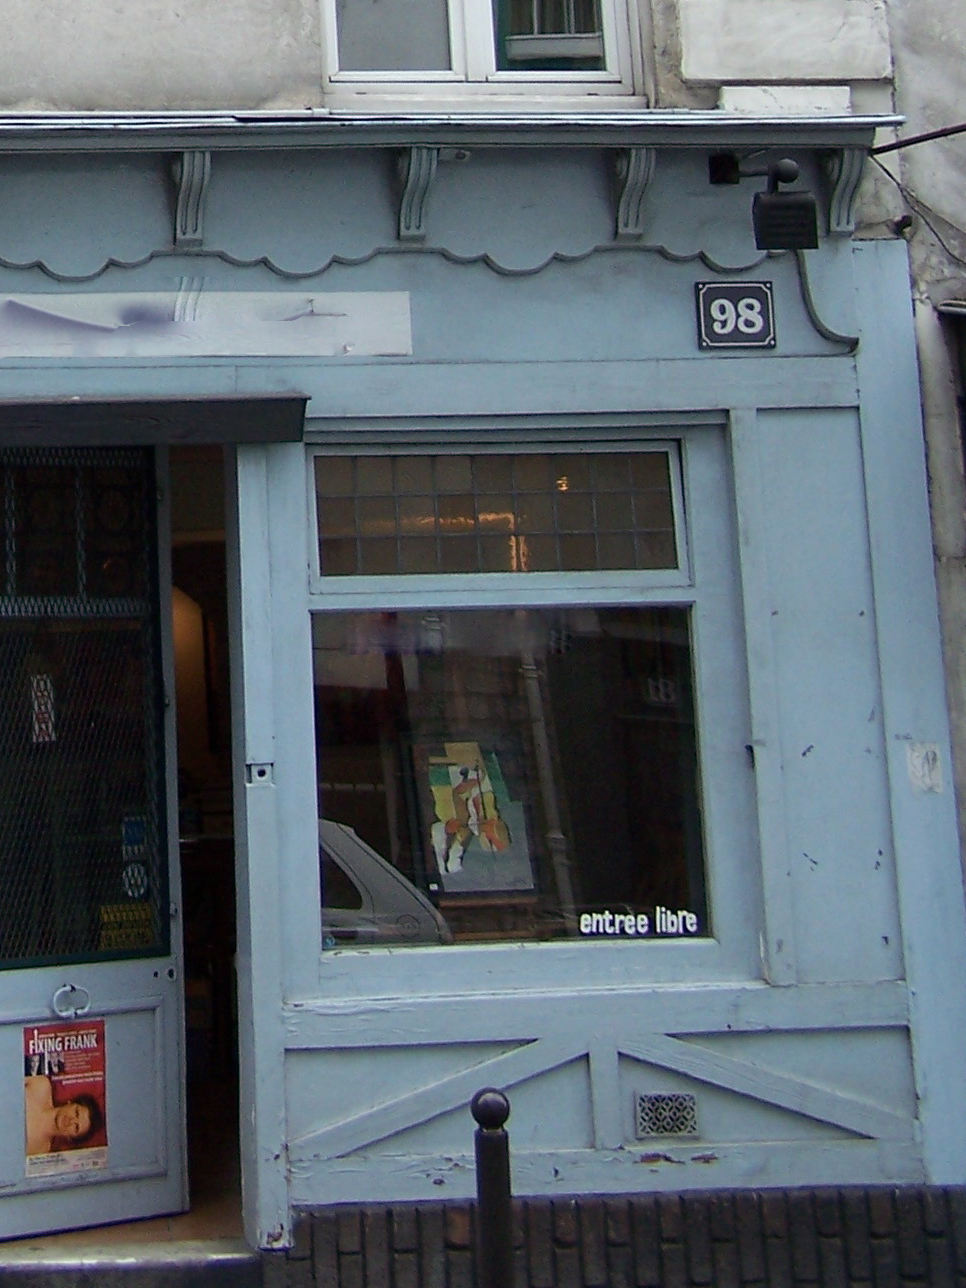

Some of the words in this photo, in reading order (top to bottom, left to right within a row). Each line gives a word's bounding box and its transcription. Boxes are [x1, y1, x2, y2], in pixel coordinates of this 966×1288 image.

[710, 298, 763, 334] 98
[579, 910, 649, 934] entree
[655, 905, 698, 933] libre
[64, 1034, 98, 1051] FRANK
